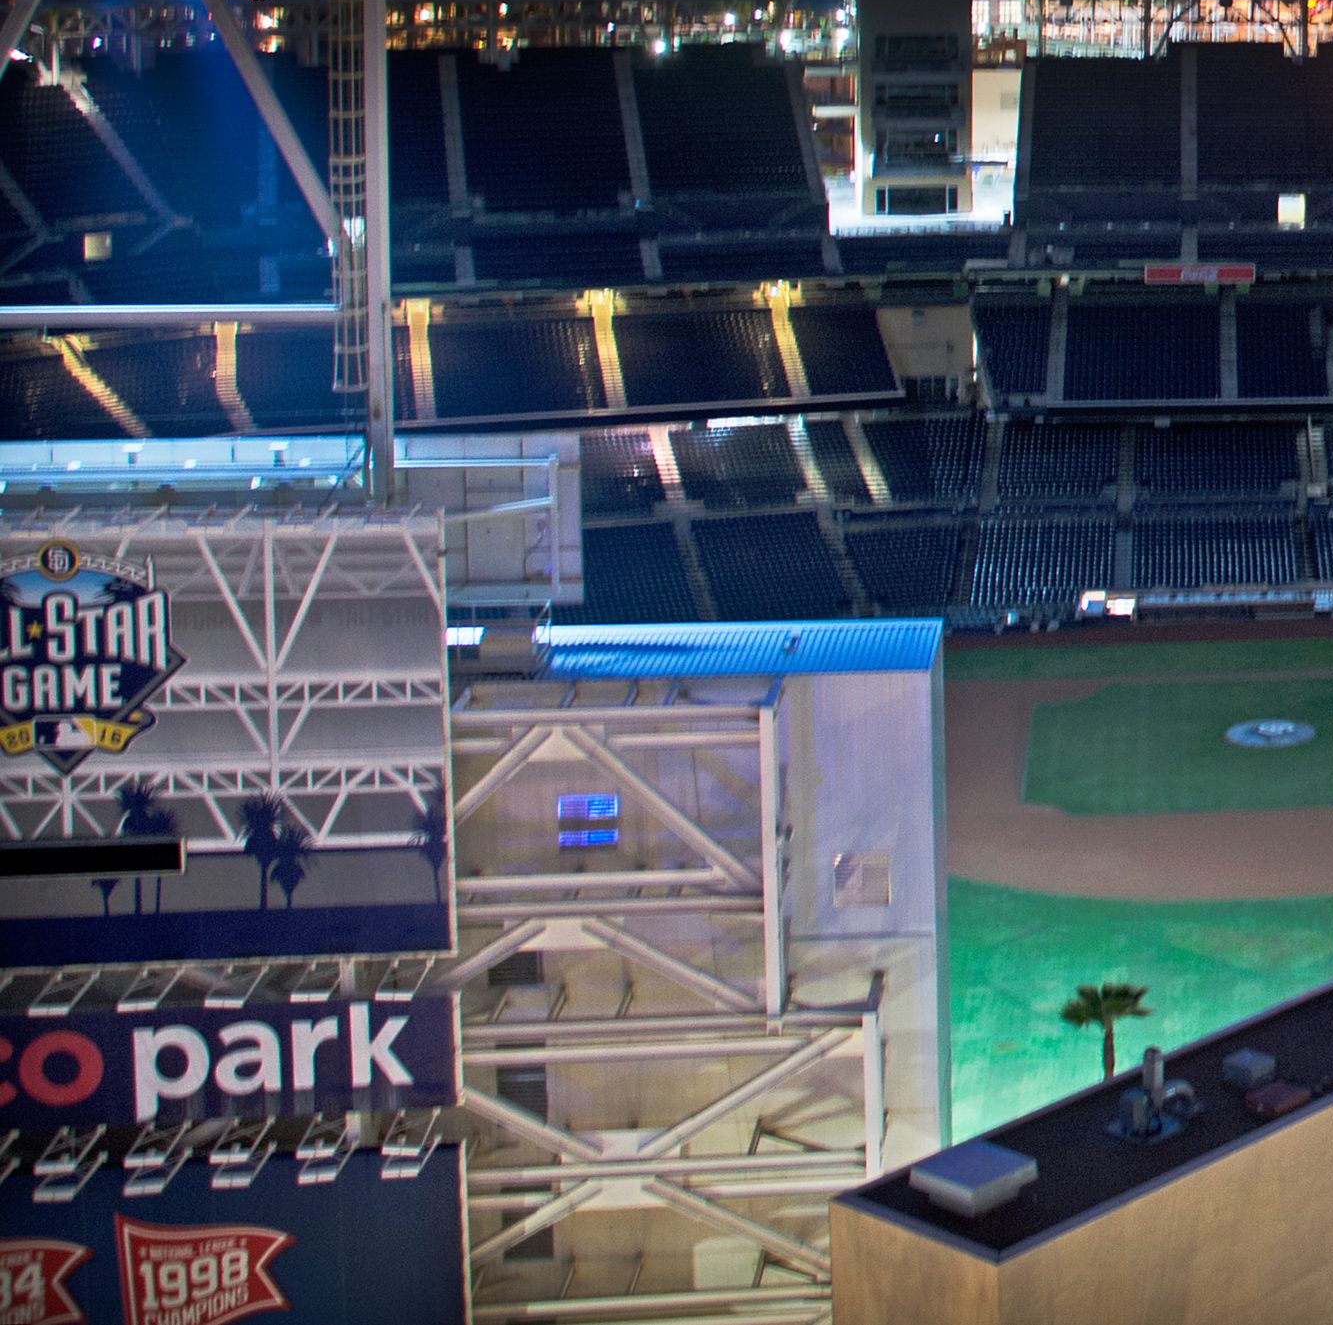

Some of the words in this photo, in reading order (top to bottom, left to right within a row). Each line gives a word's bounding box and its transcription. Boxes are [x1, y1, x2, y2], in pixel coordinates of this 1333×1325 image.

[0, 607, 33, 659] L
[46, 591, 168, 672] STAR
[3, 663, 123, 712] GAME
[0, 1029, 104, 1107] o
[133, 1002, 414, 1123] park
[139, 1248, 249, 1311] 1998
[145, 1282, 249, 1325] CHAMPIONS
